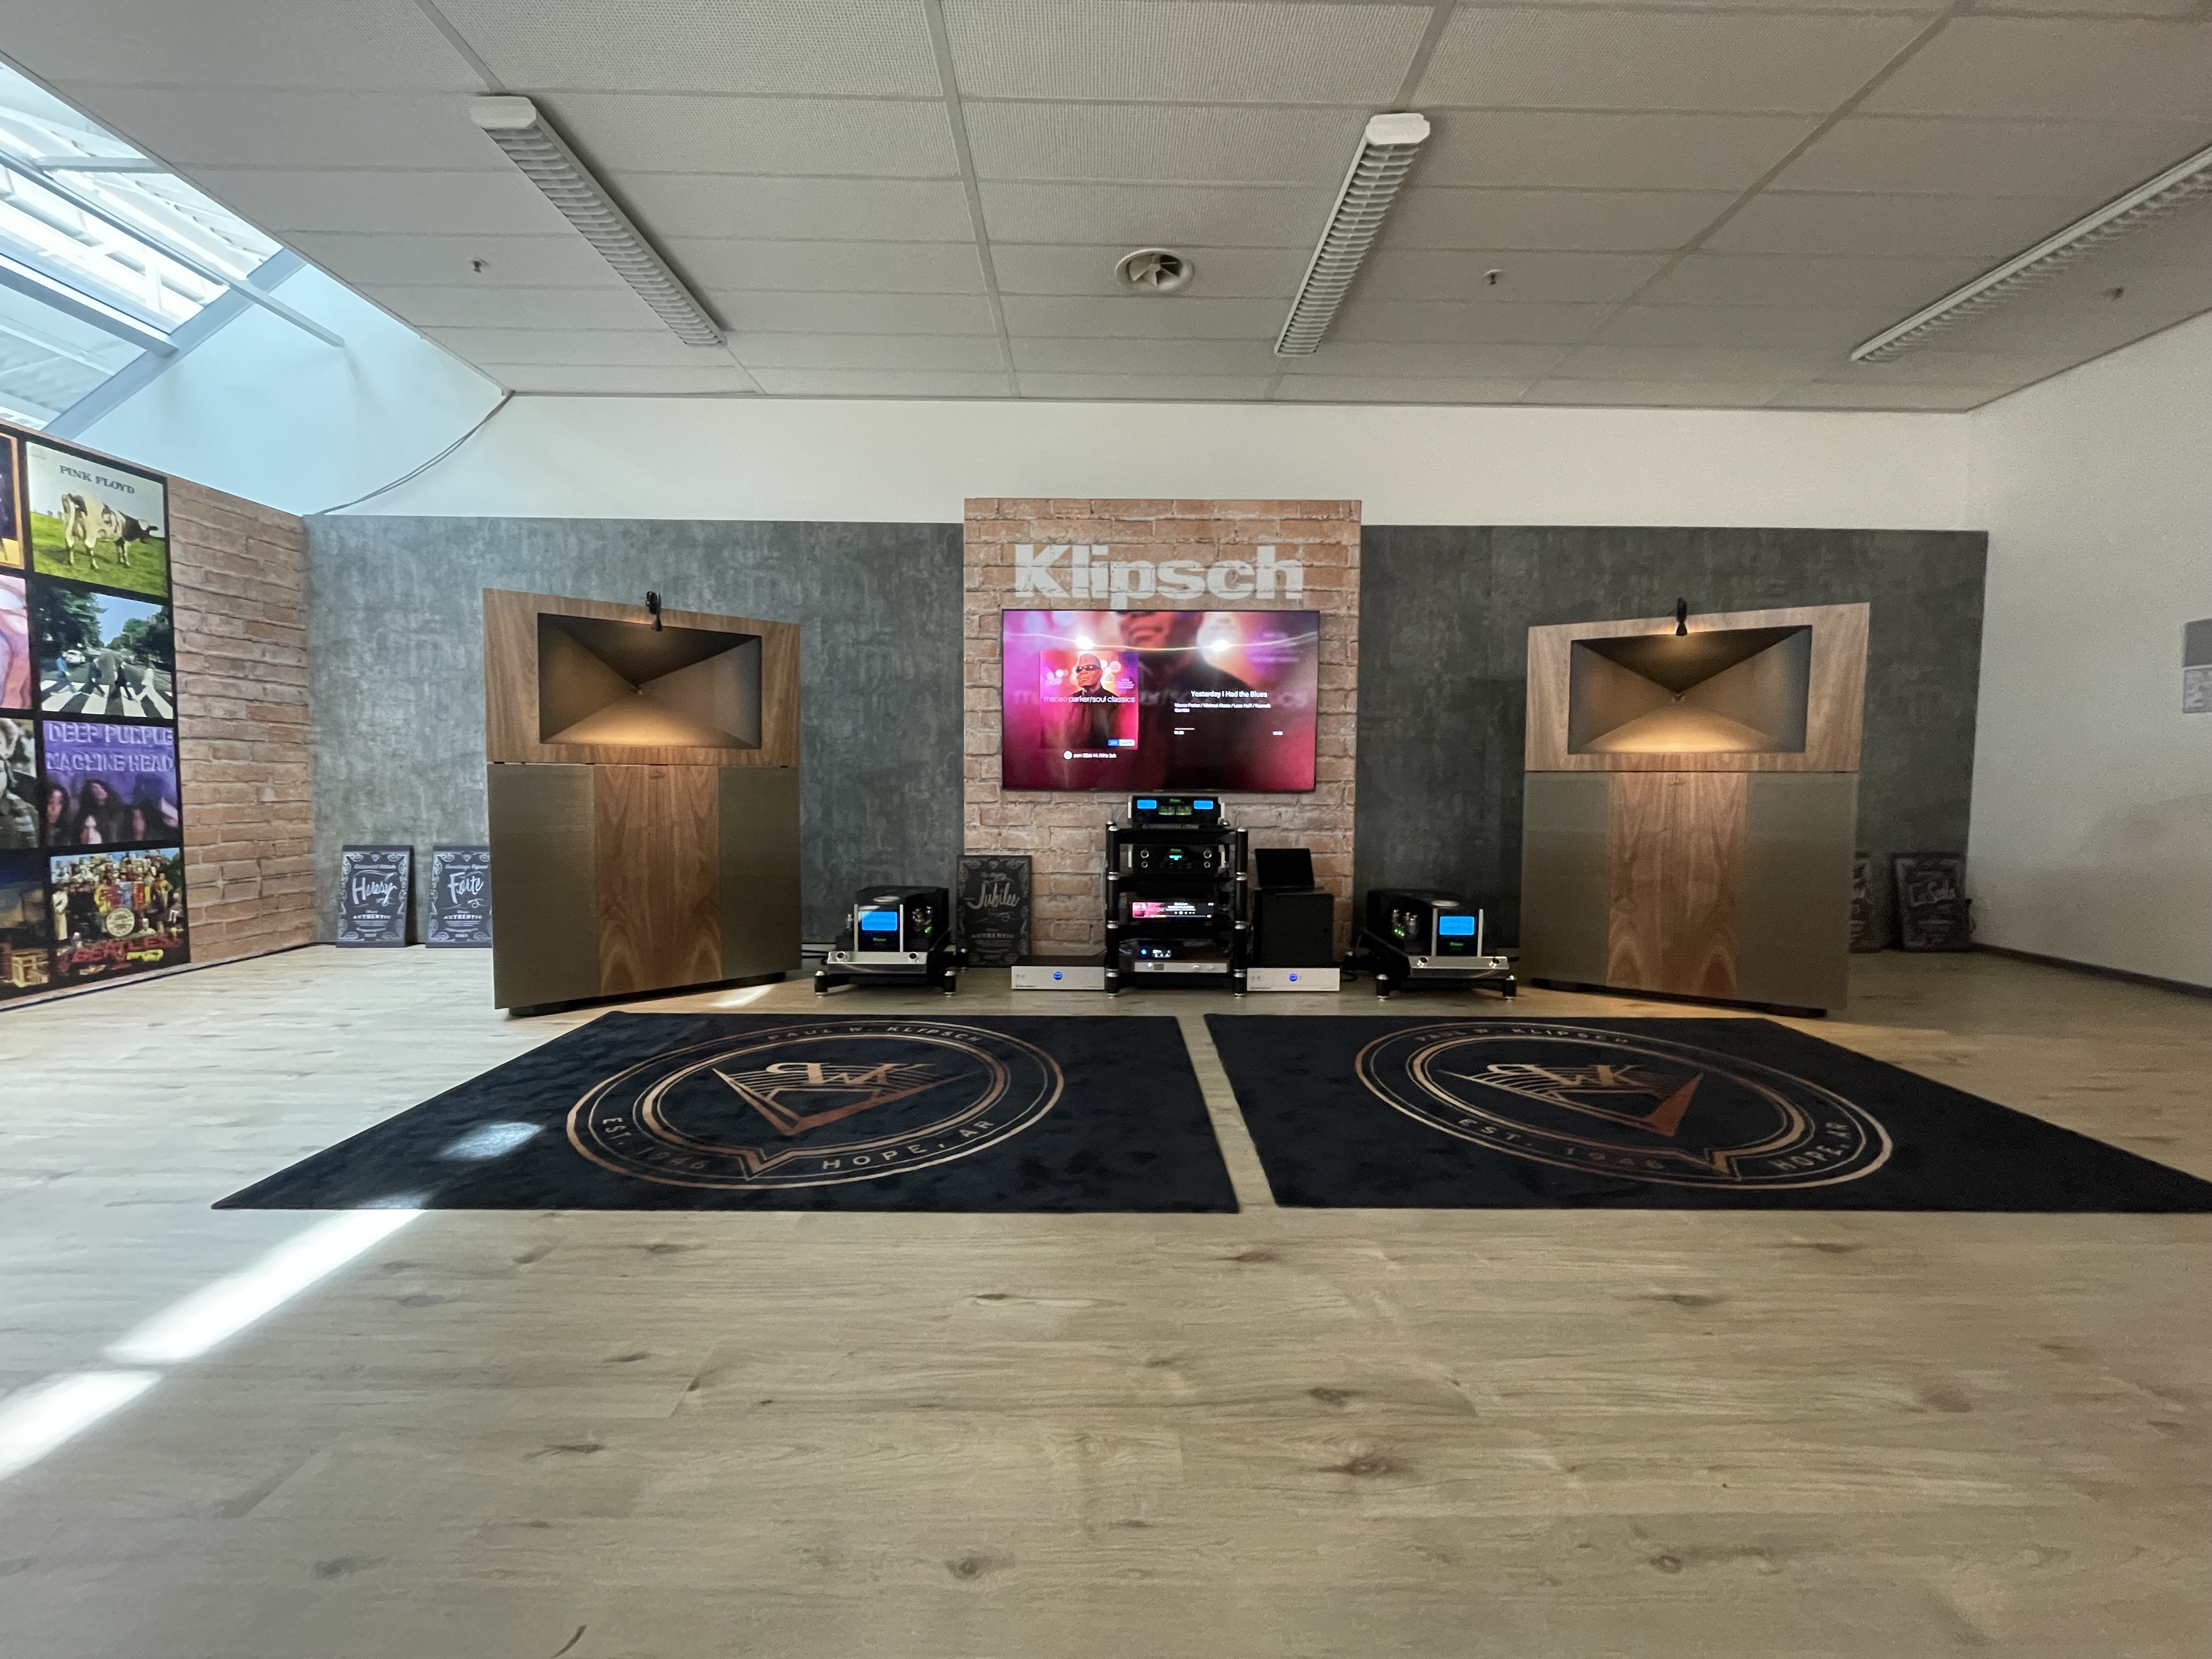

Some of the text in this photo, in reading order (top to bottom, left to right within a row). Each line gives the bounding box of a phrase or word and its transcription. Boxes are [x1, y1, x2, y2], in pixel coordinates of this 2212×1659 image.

[59, 464, 135, 494] PINK FLOYD
[1015, 544, 1304, 610] Klipsch
[1190, 690, 1221, 698] Yesterday
[48, 722, 102, 743] DEEP
[128, 753, 174, 772] HEAD
[887, 1025, 983, 1042] KLIPSCH
[822, 1120, 995, 1170] HOPE, AR
